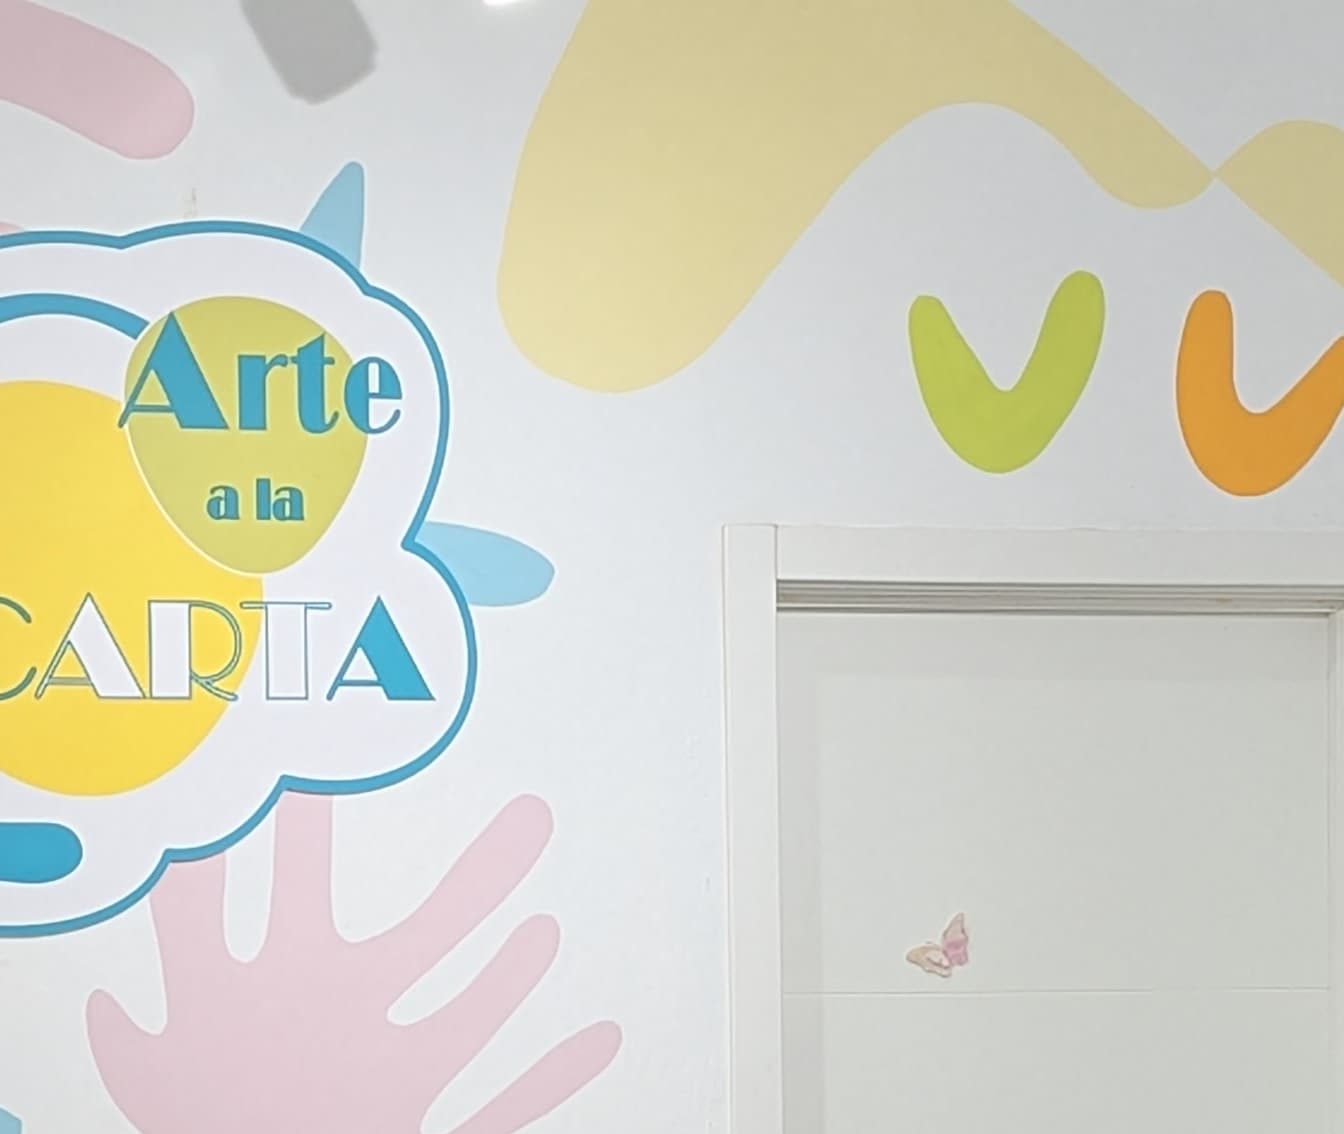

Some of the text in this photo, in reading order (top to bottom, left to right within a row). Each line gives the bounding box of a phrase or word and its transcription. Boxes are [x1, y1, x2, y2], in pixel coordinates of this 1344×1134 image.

[117, 310, 403, 435] Arte
[206, 477, 305, 521] a la
